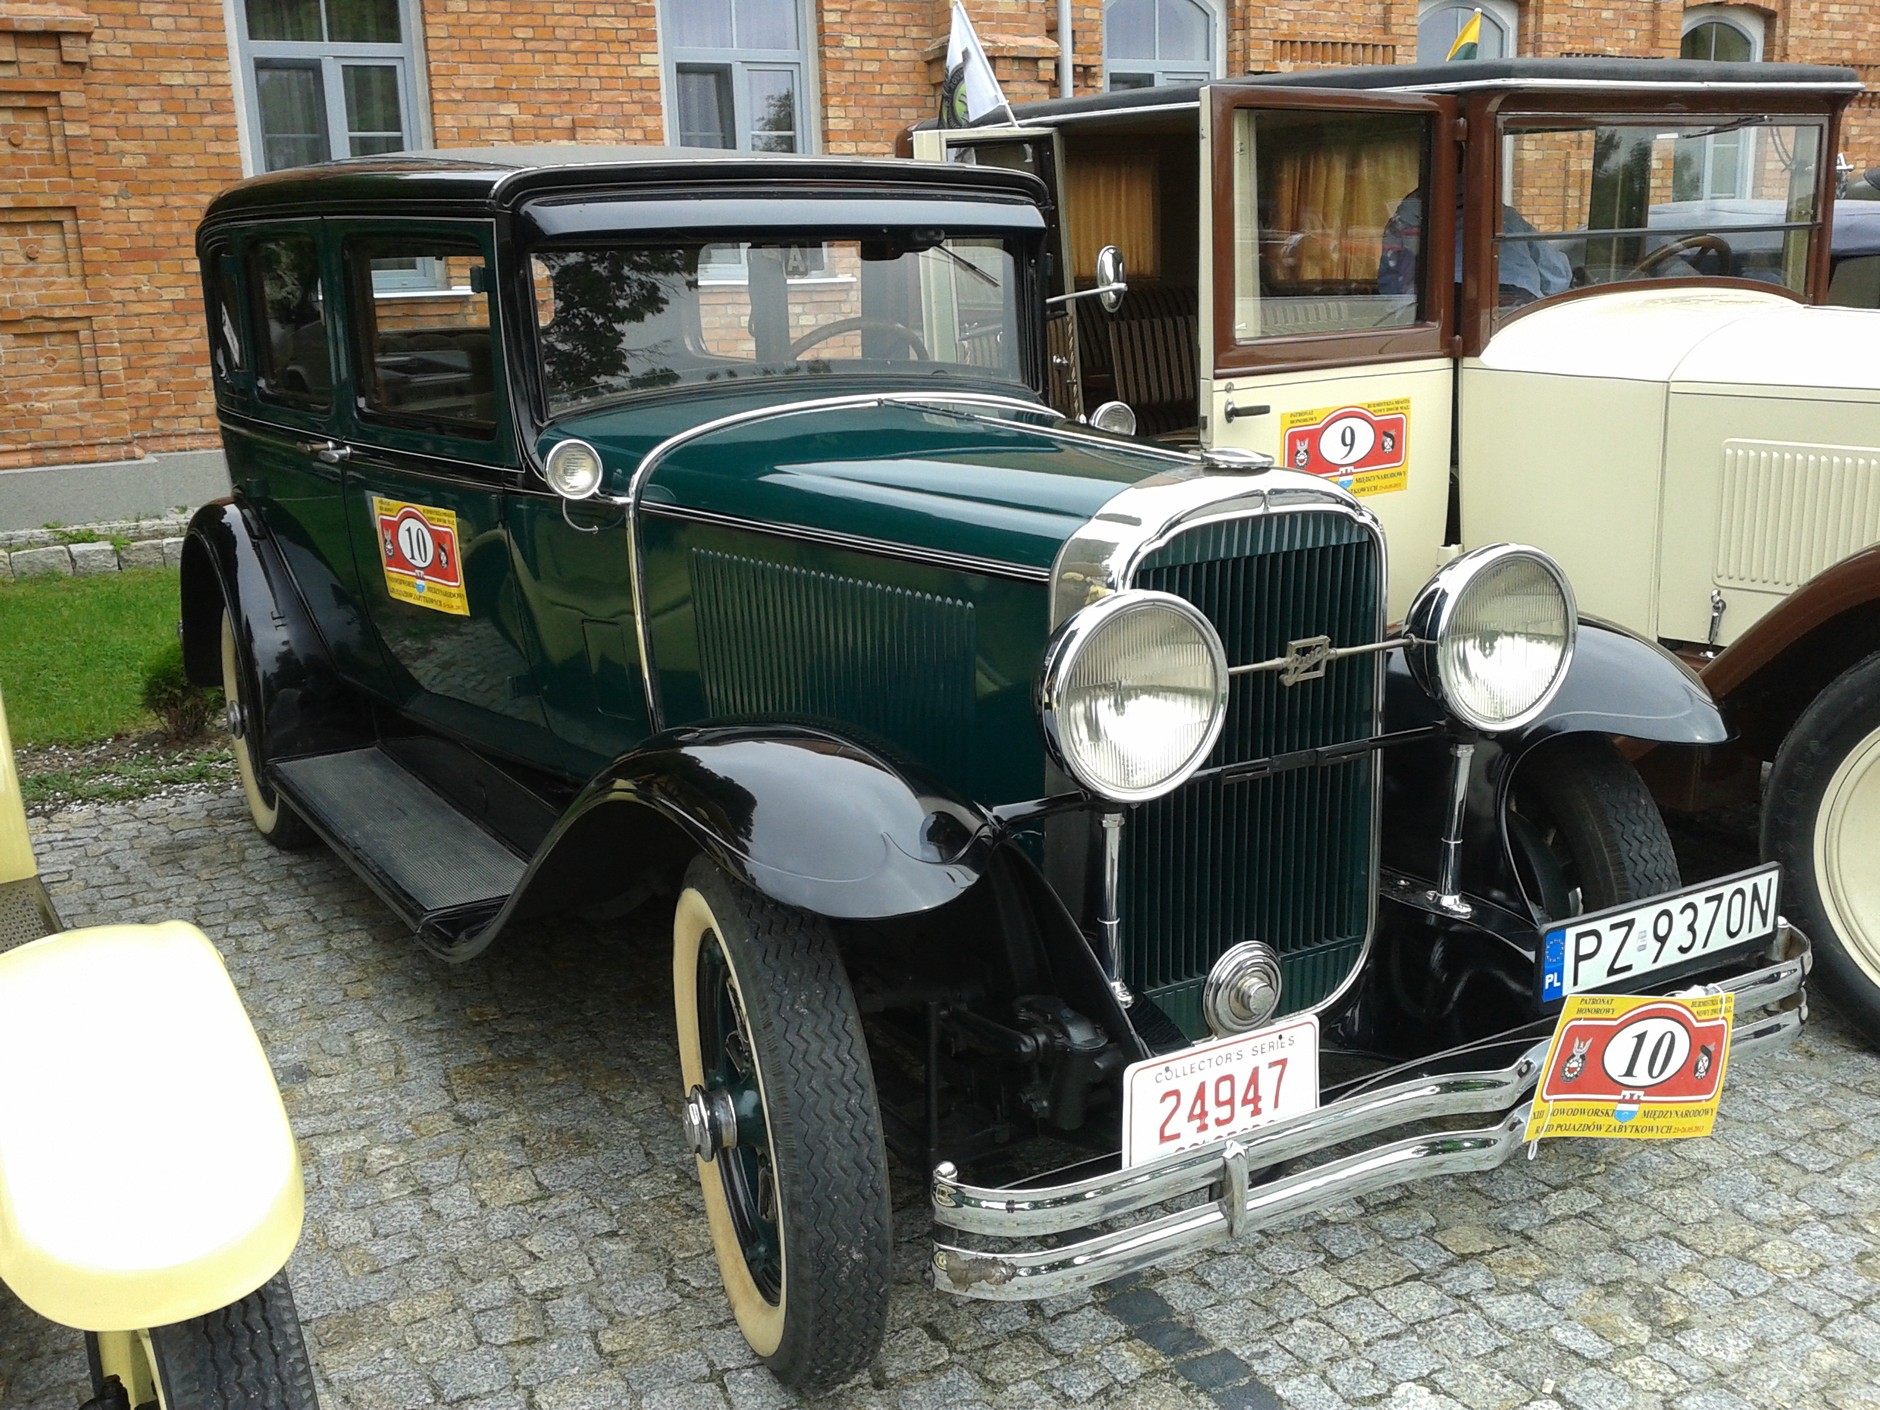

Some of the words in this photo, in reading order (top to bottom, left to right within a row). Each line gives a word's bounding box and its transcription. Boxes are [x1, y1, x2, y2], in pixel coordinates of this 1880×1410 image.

[1340, 425, 1356, 460] 9
[405, 525, 428, 563] 10
[1573, 917, 1636, 987] PZ
[1651, 877, 1773, 965] 9370N
[1545, 972, 1561, 990] PL
[1576, 1007, 1616, 1015] HONOROWY
[1579, 998, 1615, 1006] PATRONAT
[1154, 1050, 1244, 1084] COLLECTOR'S
[1251, 1035, 1296, 1057] SERIES
[1618, 1030, 1676, 1079] 10
[1159, 1057, 1288, 1145] 24947
[1642, 1108, 1716, 1121] MIĘDZYNARODOWY
[1555, 1121, 1603, 1133] POJAZDÓW
[1605, 1123, 1673, 1135] ZABYTKOWYCH
